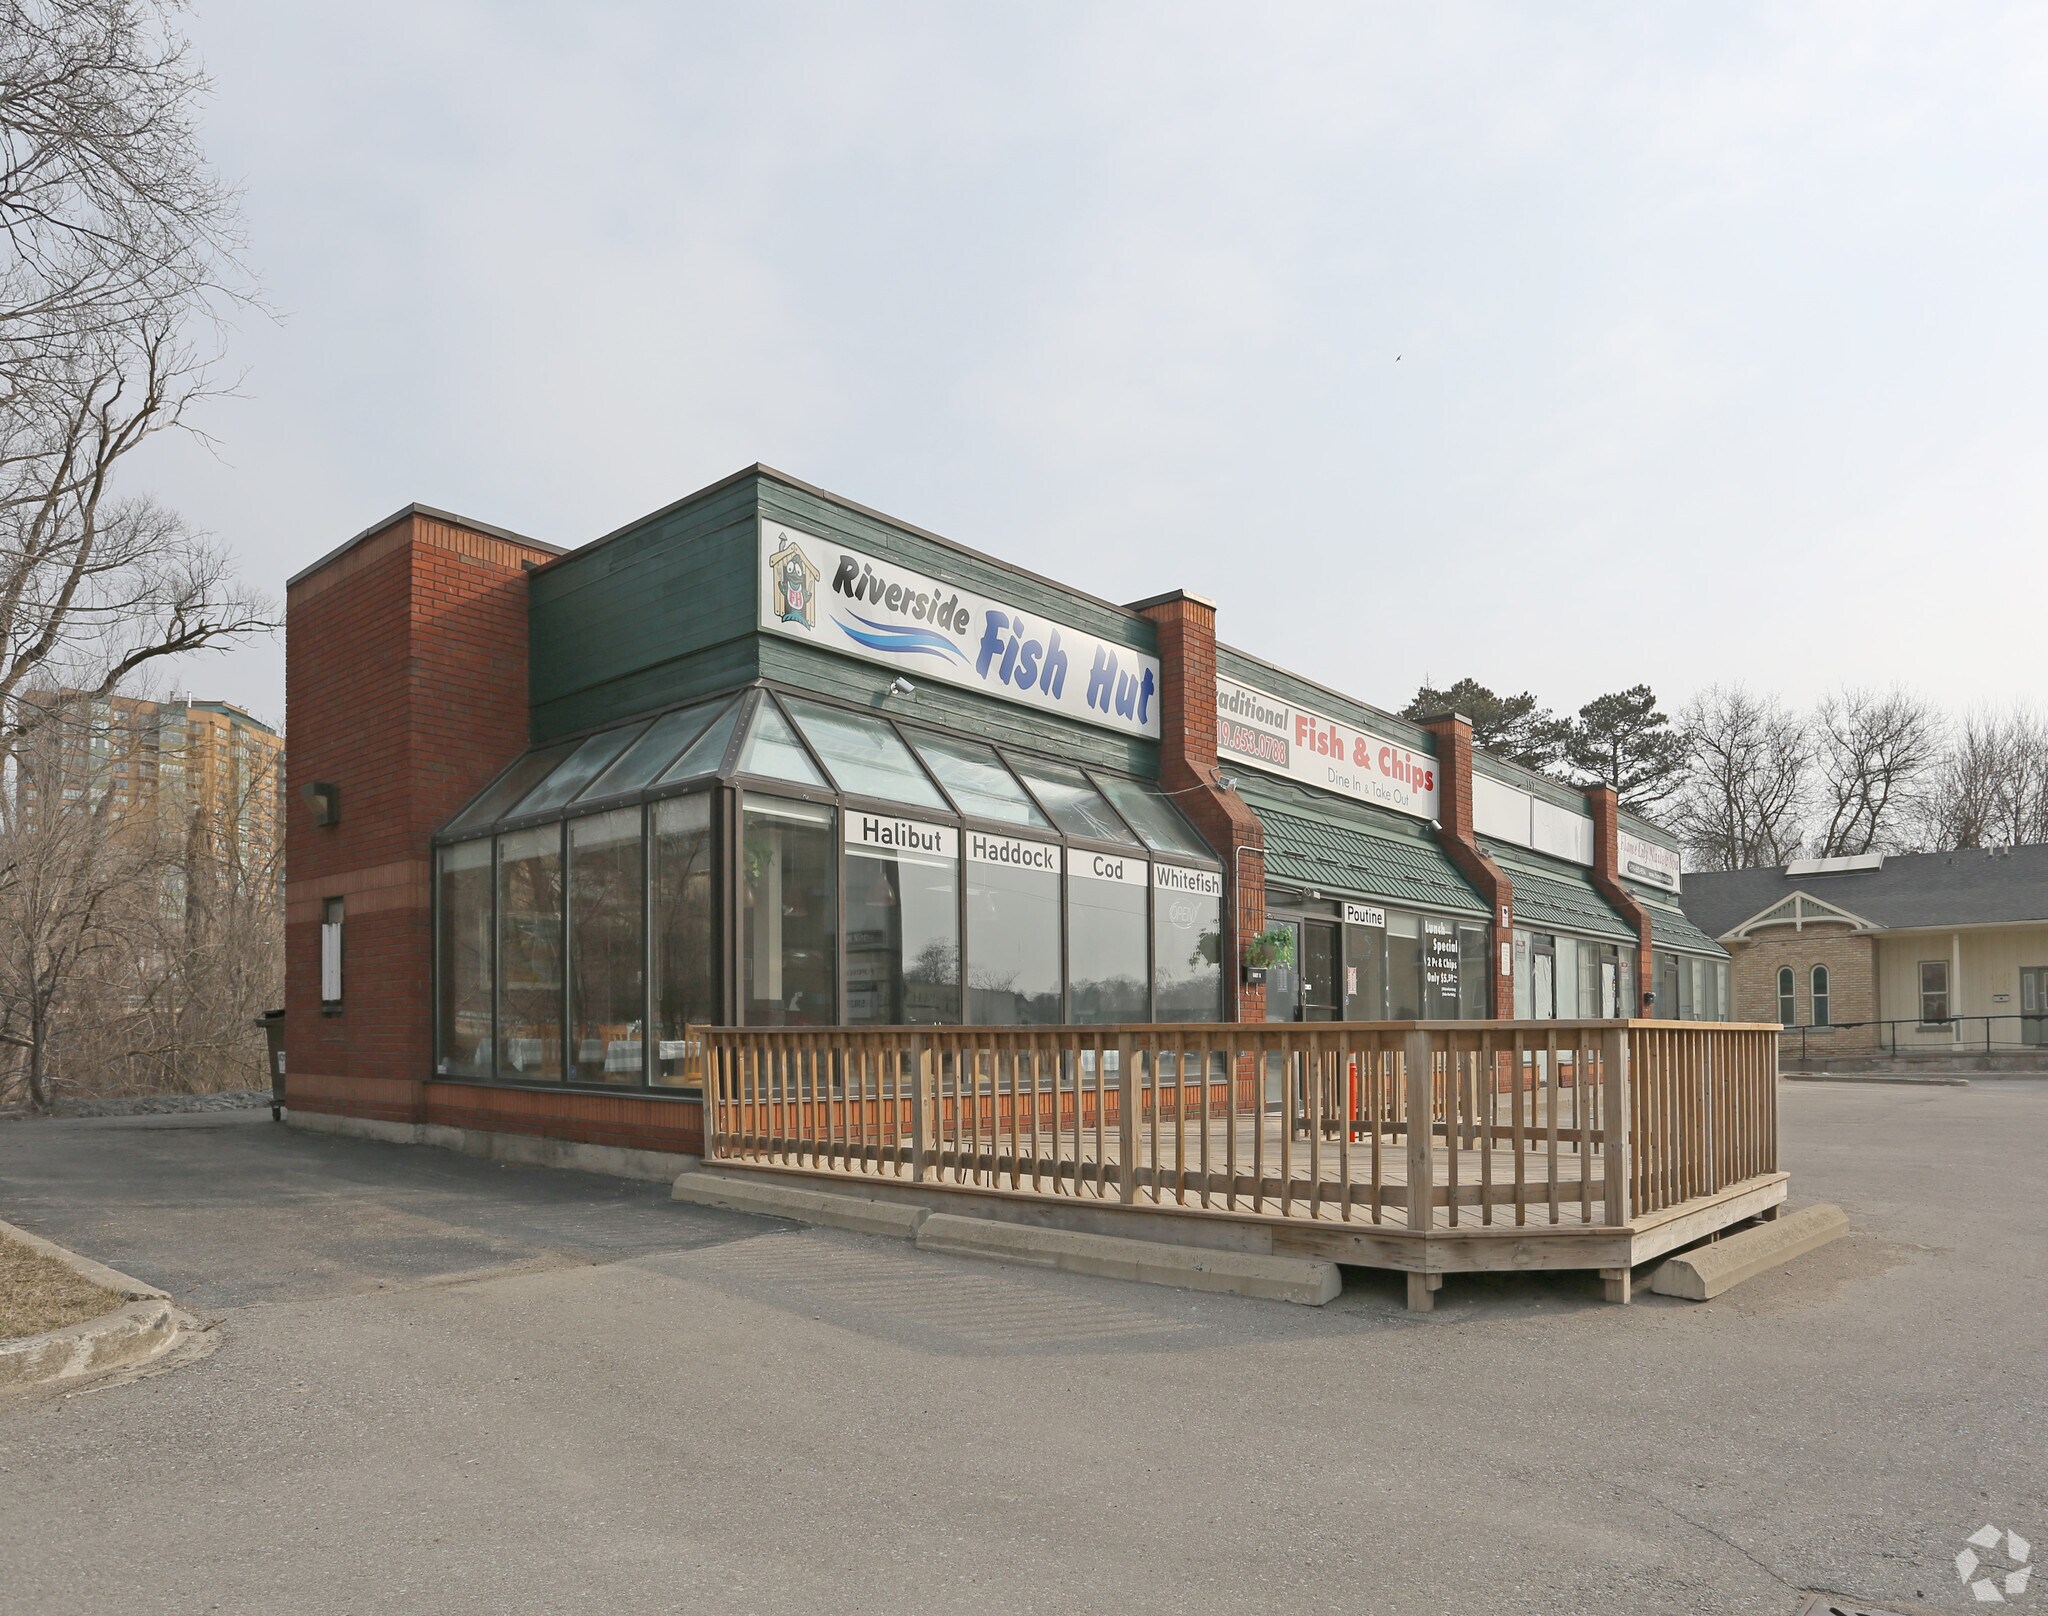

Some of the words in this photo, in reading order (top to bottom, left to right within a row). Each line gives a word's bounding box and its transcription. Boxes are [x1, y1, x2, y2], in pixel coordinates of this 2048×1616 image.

[832, 554, 970, 636] Riverside
[976, 610, 1069, 700] Fish
[1086, 643, 1155, 725] Hut
[1216, 689, 1289, 731] aditional
[1295, 714, 1345, 761] Fish
[1353, 736, 1371, 770] &
[1378, 746, 1434, 794] Chips
[1327, 767, 1349, 789] Dine
[1352, 775, 1361, 792] In
[1364, 784, 1369, 794] &
[1371, 781, 1391, 801] Take
[1393, 788, 1409, 806] Out
[863, 817, 942, 852] Halibut
[973, 835, 1054, 869] Haddock
[1093, 856, 1124, 880] Cod
[1156, 866, 1219, 894] Whitefish
[1170, 905, 1194, 921] OPEN
[1347, 906, 1382, 924] Poutine
[1425, 920, 1446, 935] Lunch
[1433, 938, 1458, 954] Special
[1427, 957, 1431, 967] 2
[1443, 959, 1457, 971] Chips
[1427, 972, 1440, 985] Only
